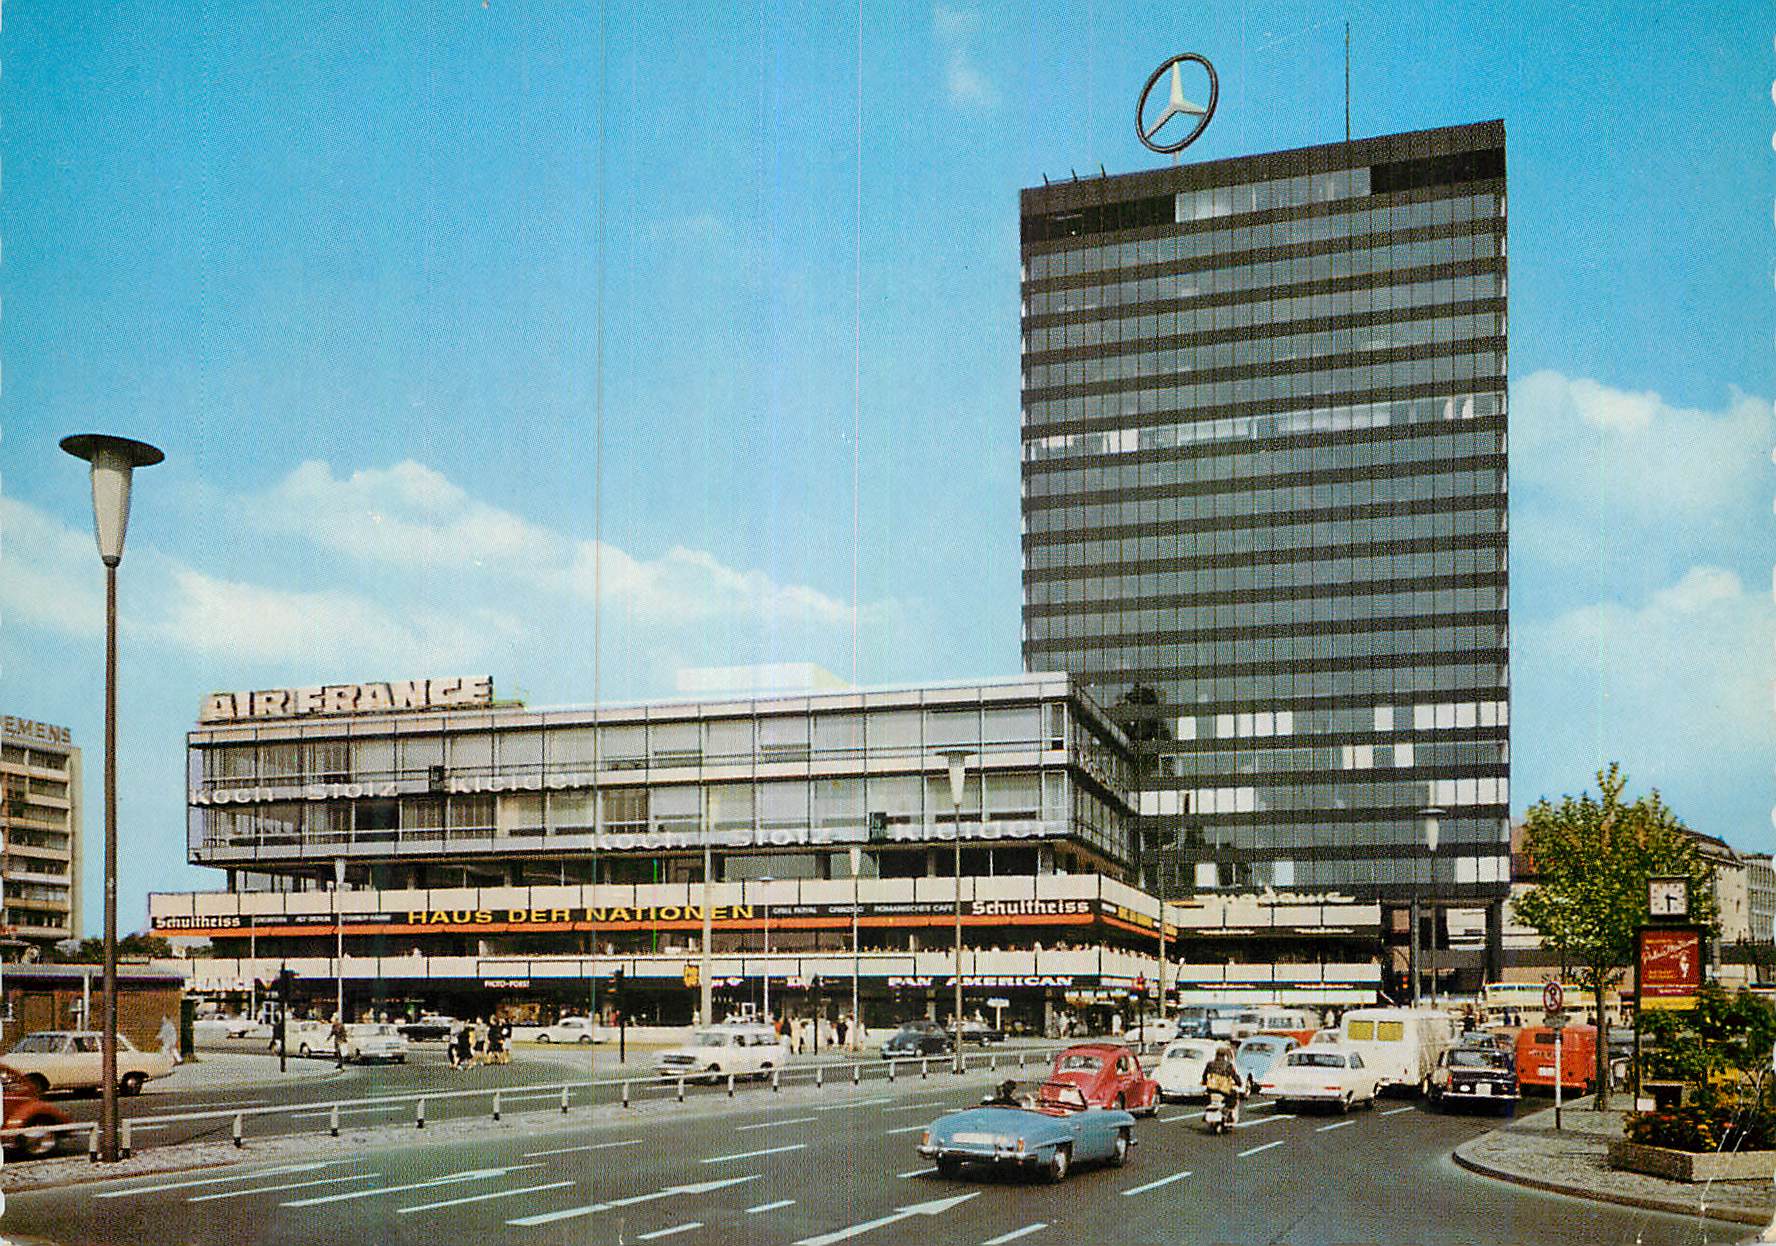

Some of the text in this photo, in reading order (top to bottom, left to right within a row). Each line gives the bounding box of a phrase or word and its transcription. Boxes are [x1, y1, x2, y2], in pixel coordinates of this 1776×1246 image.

[200, 675, 494, 719] AIR FRANCE
[408, 905, 753, 924] HAUS DER NATIONEN
[972, 900, 1090, 915] Schultheiss
[155, 915, 241, 929] Schultheiss
[887, 975, 1074, 987] PAN AMERICAN
